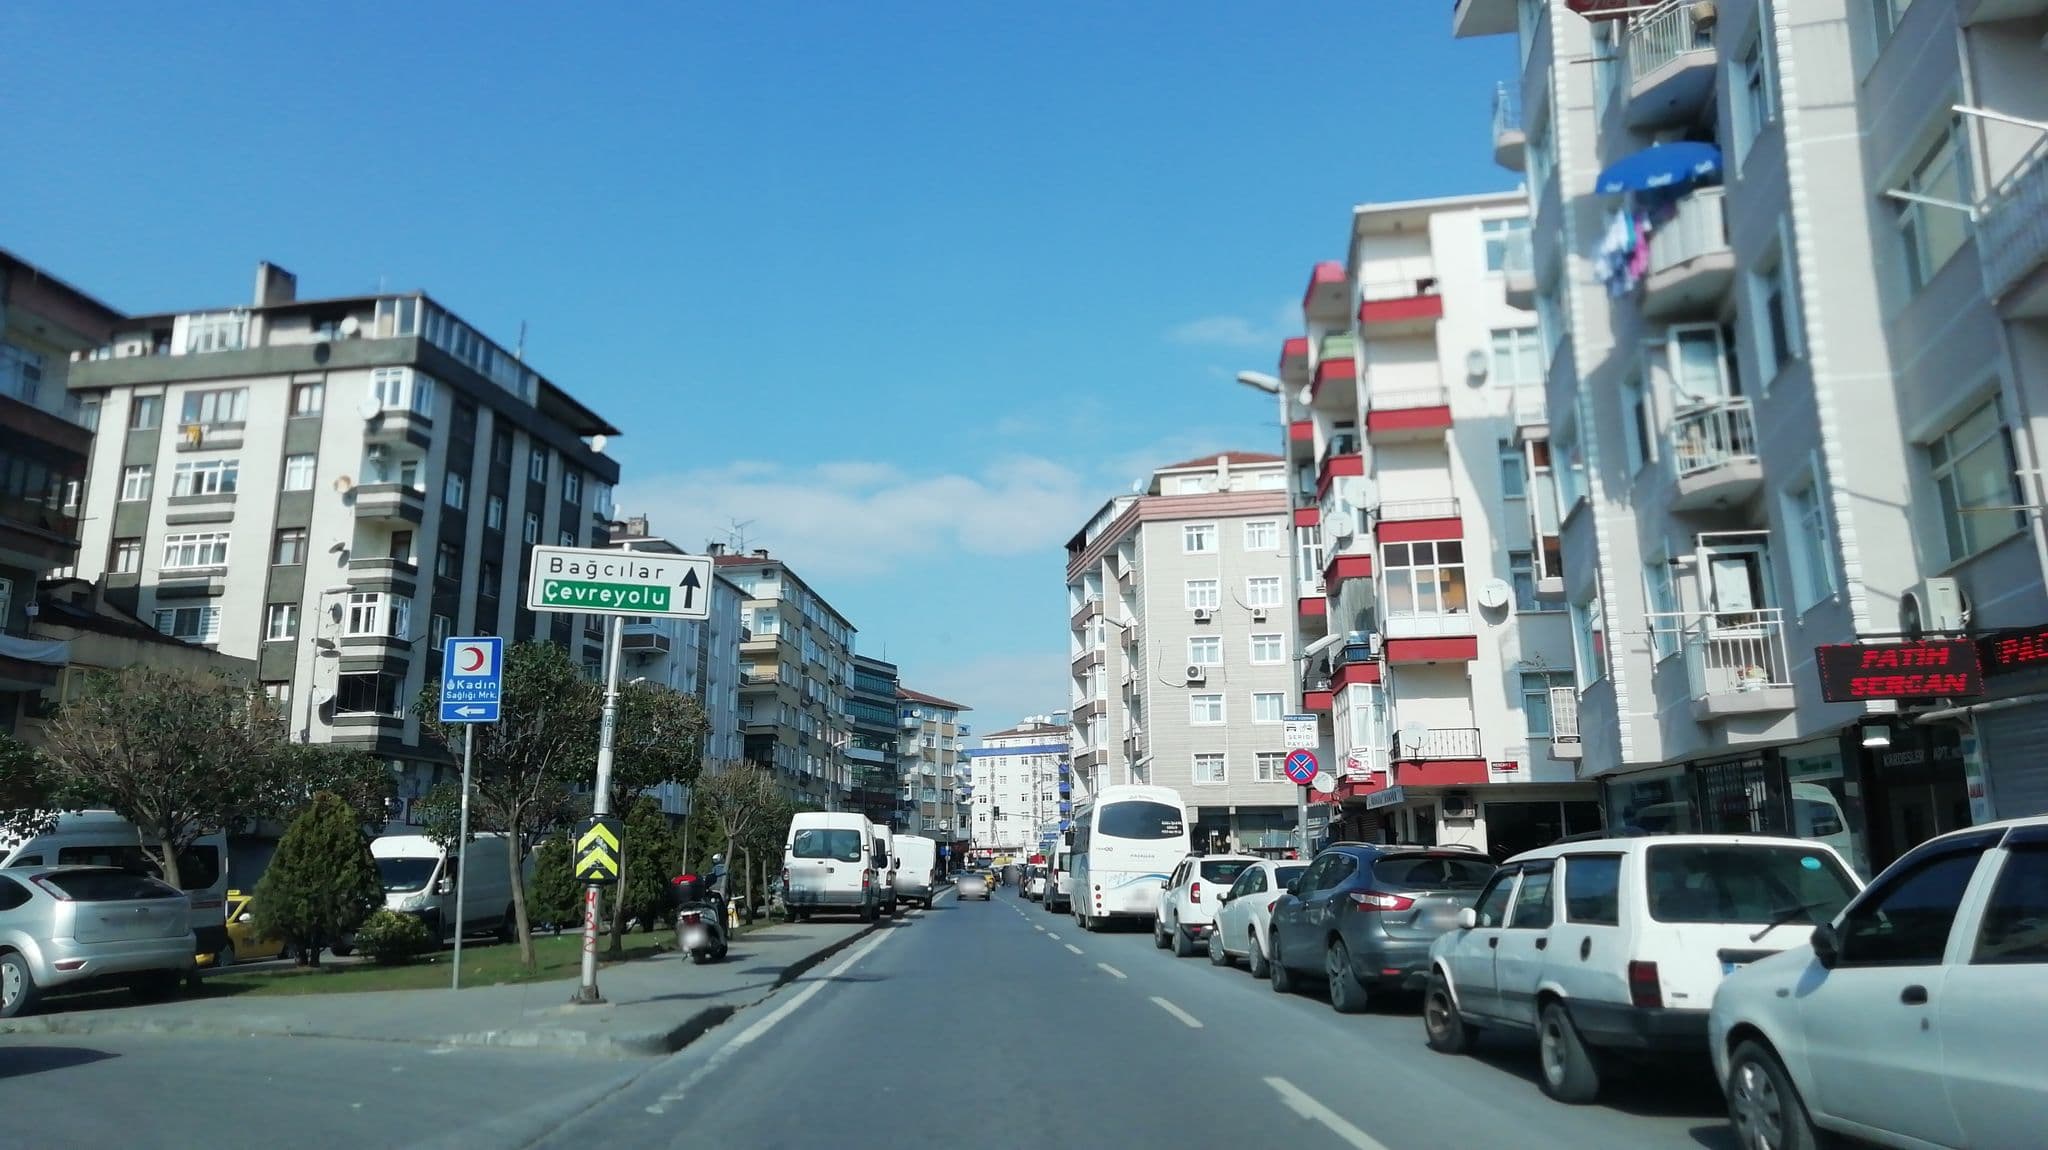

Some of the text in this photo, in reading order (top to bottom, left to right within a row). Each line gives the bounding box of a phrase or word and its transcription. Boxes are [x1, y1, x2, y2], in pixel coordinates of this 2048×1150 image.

[550, 558, 664, 580] Bağcılar
[545, 581, 664, 606] Çevreyolu
[456, 680, 496, 690] Kadın
[1850, 673, 1968, 695] SERCAN
